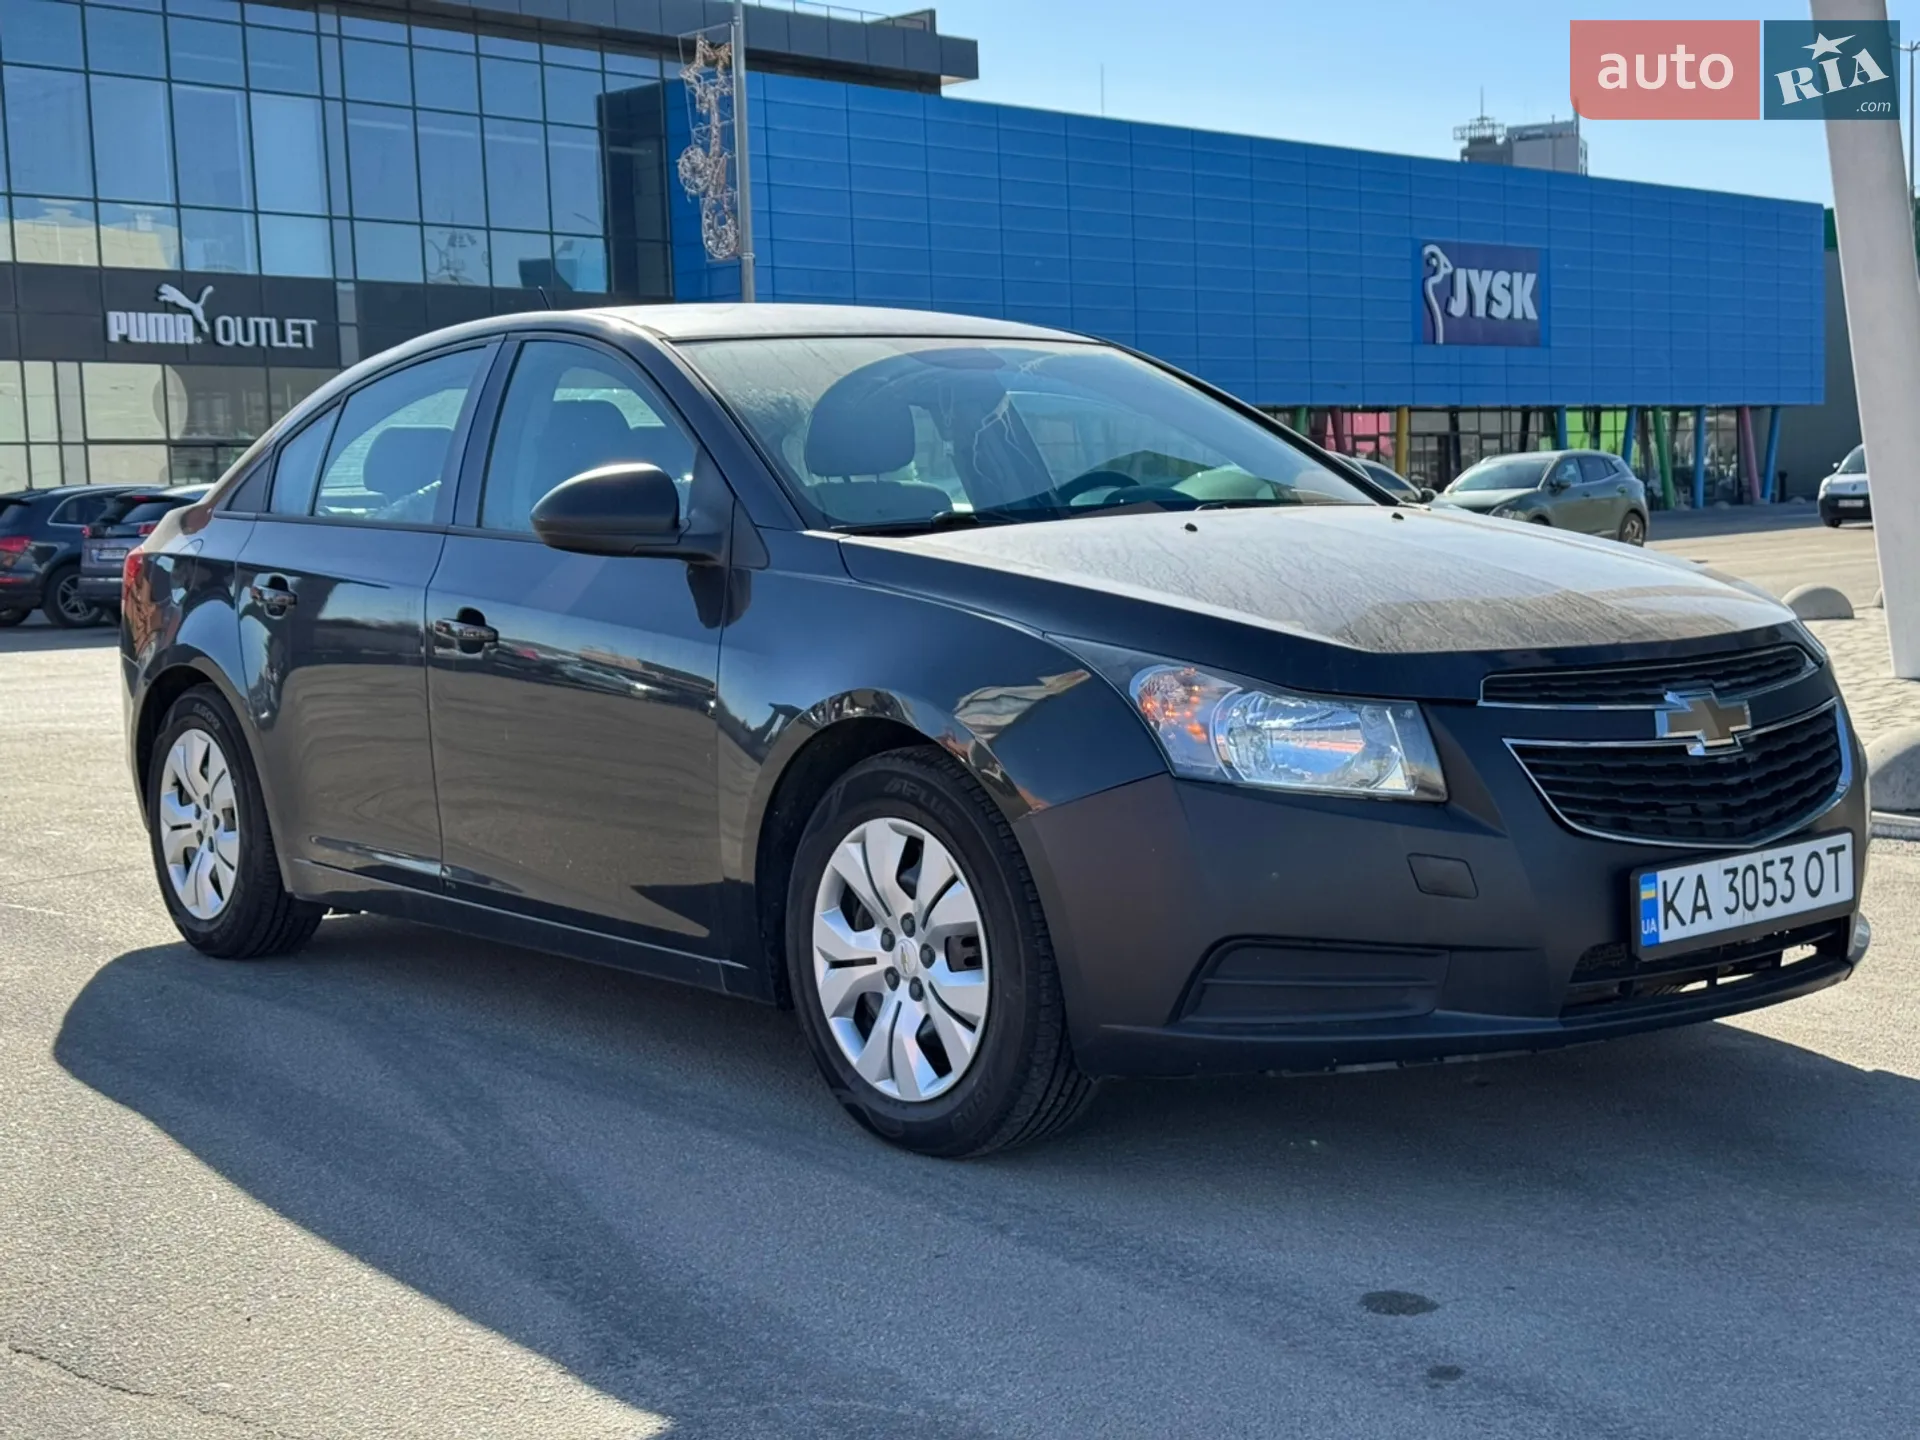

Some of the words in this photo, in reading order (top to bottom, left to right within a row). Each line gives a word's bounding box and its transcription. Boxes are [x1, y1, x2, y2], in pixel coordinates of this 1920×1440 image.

[1449, 267, 1538, 320] JYSK
[106, 311, 195, 344] PUMA
[214, 315, 318, 348] OUTLET
[1662, 873, 1713, 931] KA
[1723, 855, 1796, 915] 3053
[1804, 844, 1847, 899] OT
[1641, 917, 1658, 935] UA
